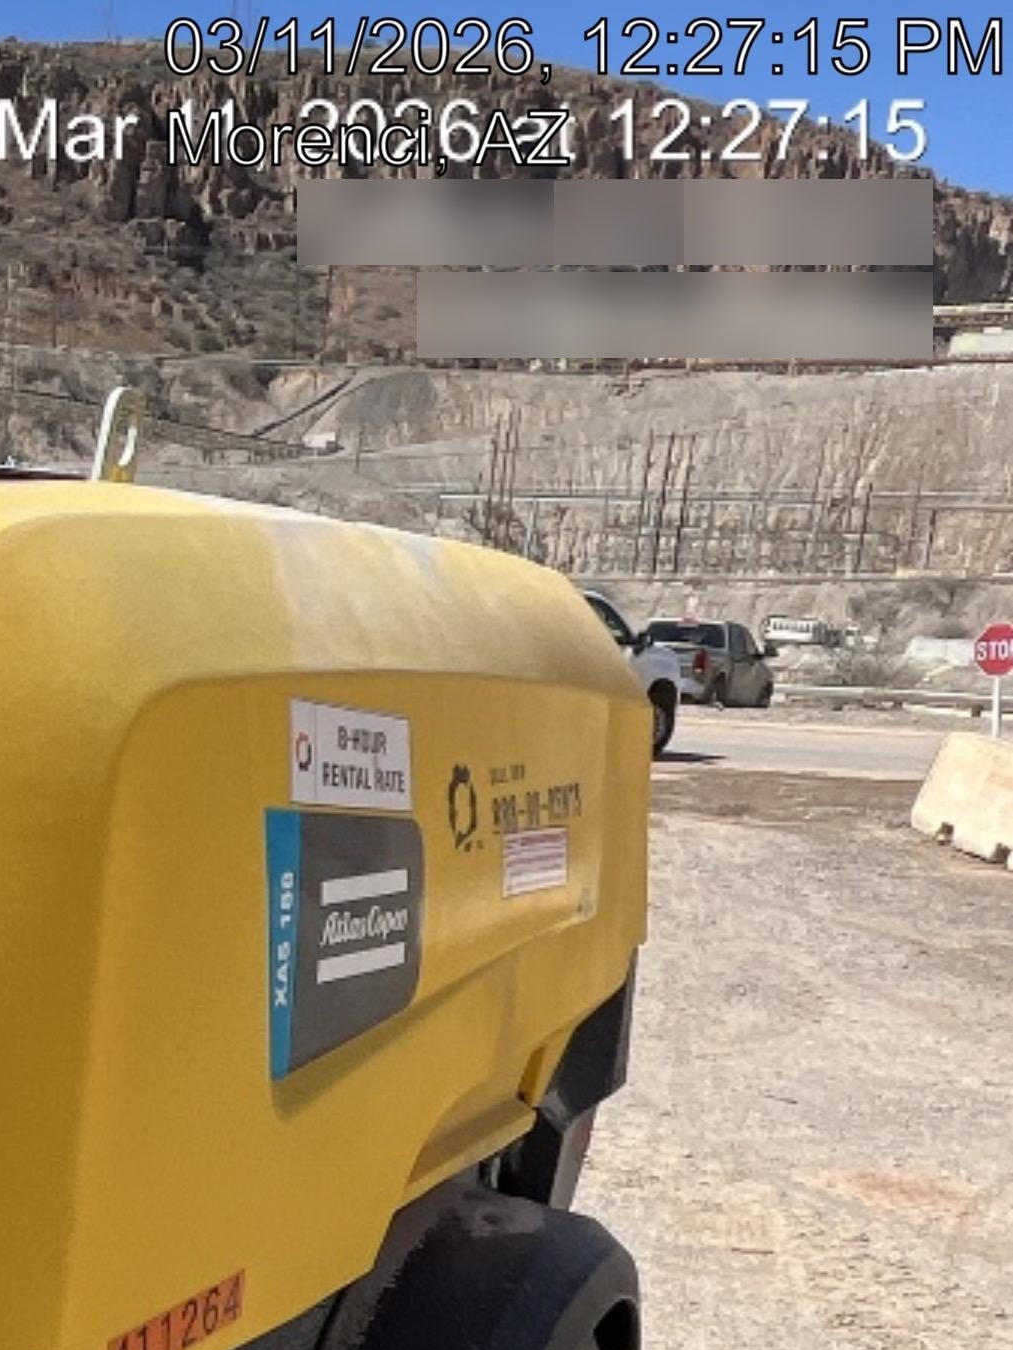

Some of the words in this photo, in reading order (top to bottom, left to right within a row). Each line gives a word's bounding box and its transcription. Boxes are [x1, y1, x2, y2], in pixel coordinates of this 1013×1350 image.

[976, 641, 1013, 660] STO
[322, 761, 372, 789] RENTAL
[374, 768, 405, 793] RATE
[319, 911, 366, 946] Atlas
